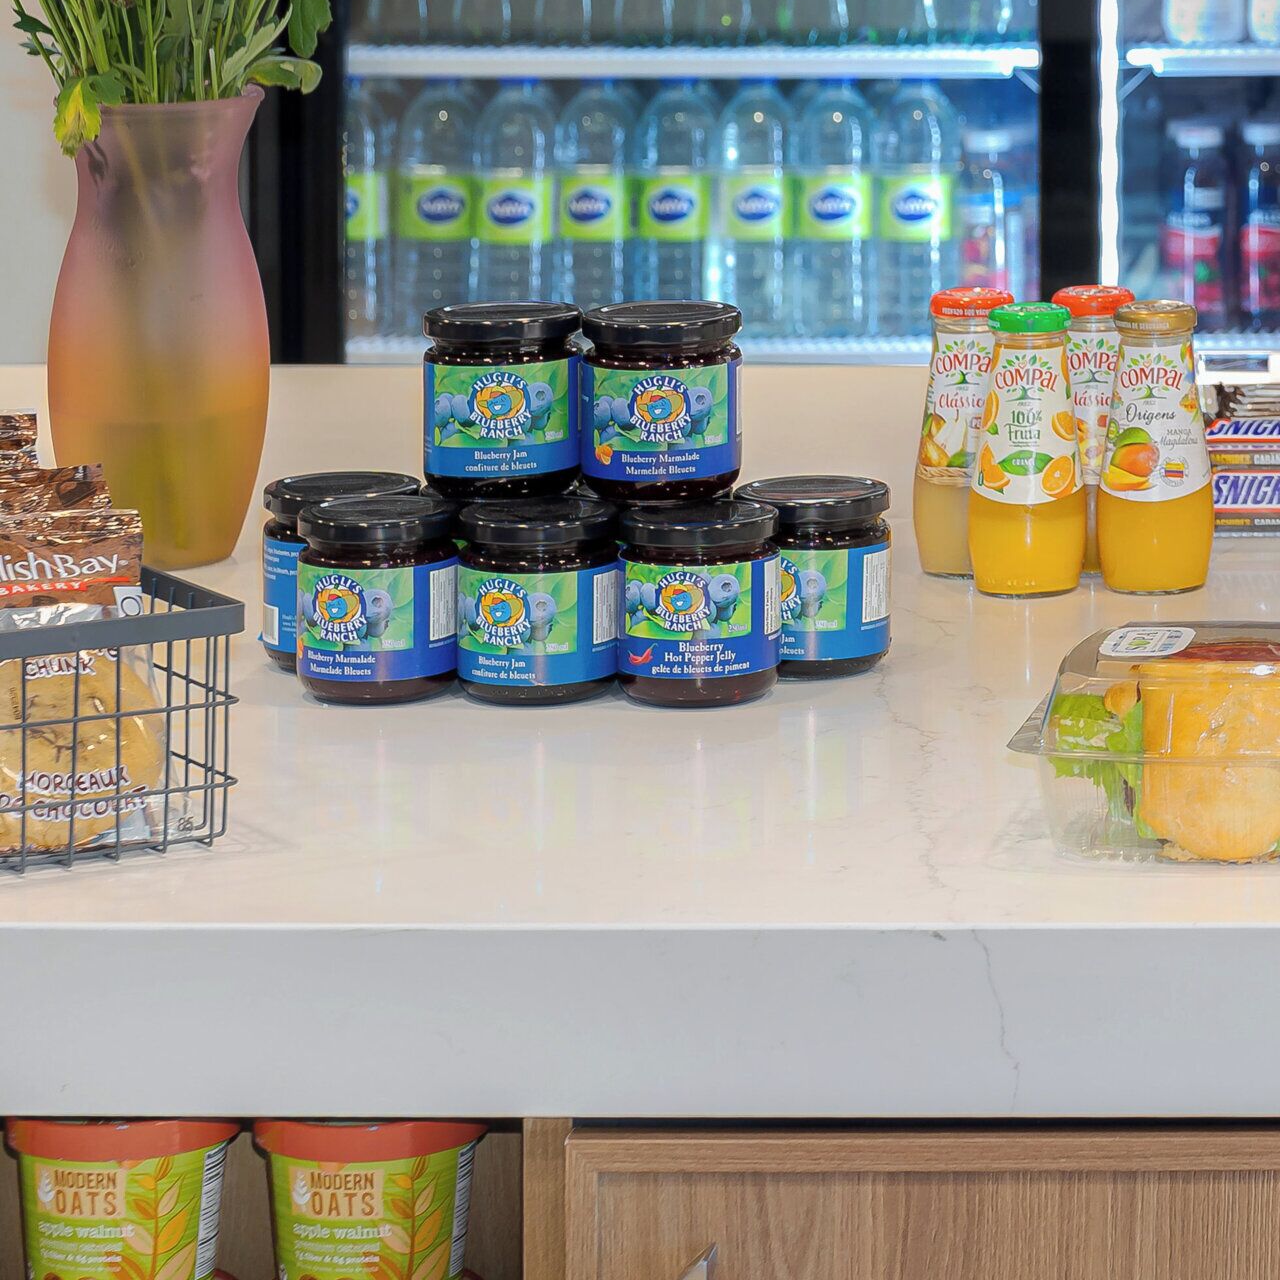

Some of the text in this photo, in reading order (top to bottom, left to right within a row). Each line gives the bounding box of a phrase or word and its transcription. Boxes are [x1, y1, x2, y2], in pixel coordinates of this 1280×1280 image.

[473, 373, 528, 392] HUGLI'S
[633, 376, 688, 395] HUGLI'S
[469, 408, 533, 429] BLUEBERRY
[1011, 410, 1042, 425] 100%
[1125, 402, 1176, 425] Origens
[629, 412, 693, 433] BLUEBERRY
[480, 426, 523, 439] RANCH
[640, 429, 683, 443] RANCH
[474, 449, 528, 460] Blueberry Jam
[621, 452, 700, 465] Blueberry Marmalade
[500, 463, 510, 471] de
[511, 461, 537, 471] bleuets
[316, 574, 363, 594] HUGLI'S
[659, 571, 707, 588] HUGLI'S
[479, 579, 527, 598] HUGLI'S
[313, 613, 367, 632] BLUEBERRY
[655, 606, 711, 624] BLUEBERRY
[475, 615, 532, 636] BLUEBERRY
[664, 621, 703, 632] RANCH
[320, 630, 358, 643] RANCH
[483, 634, 522, 646] RANCH
[679, 642, 724, 652] Blueberry
[307, 650, 376, 664] Blueberry Marmalade
[478, 656, 526, 669] Blueberry Jam
[664, 651, 736, 664] Hot Pepper Jelly
[499, 670, 508, 679] de
[651, 661, 750, 674] gelée de bleuets de piment
[53, 1169, 118, 1190] MODERN
[310, 1171, 375, 1191] MODERN
[55, 1189, 118, 1217] OATS
[311, 1190, 376, 1217] OATS
[75, 1222, 136, 1239] walnut
[333, 1222, 393, 1240] walnut
